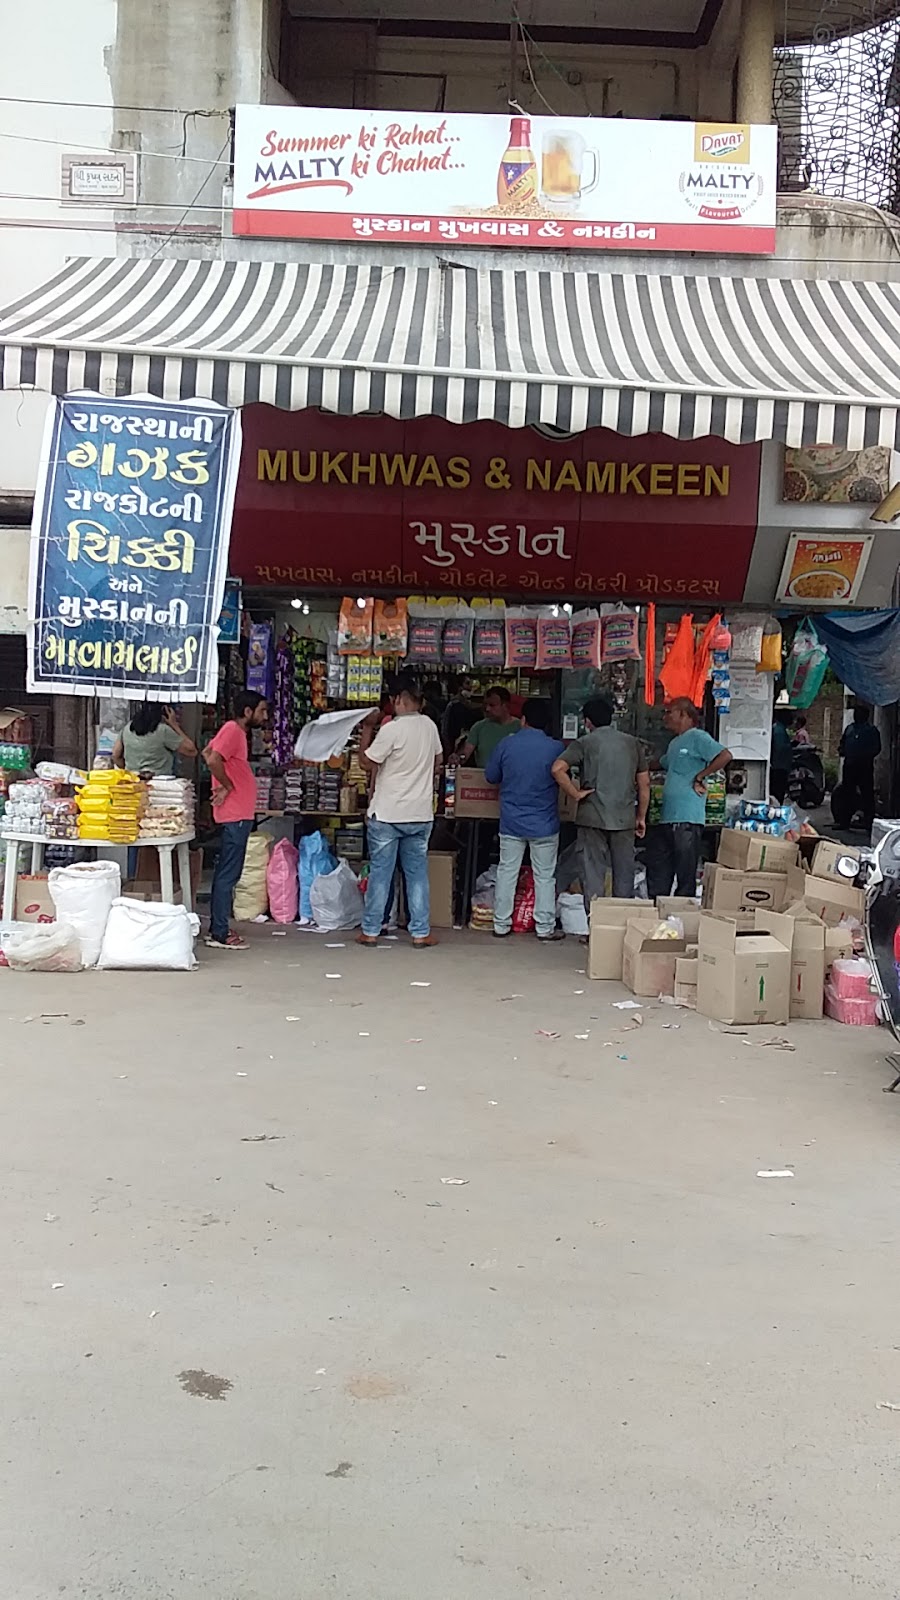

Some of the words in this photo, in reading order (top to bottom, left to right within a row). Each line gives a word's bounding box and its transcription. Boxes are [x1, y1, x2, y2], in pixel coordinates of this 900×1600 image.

[260, 130, 351, 156] Summer
[358, 126, 378, 151] ki
[384, 120, 460, 150] Rahat...
[254, 156, 344, 182] MALTY
[351, 152, 371, 178] ki
[376, 146, 465, 175] Chahat...
[687, 172, 754, 189] MALTY
[352, 217, 431, 235] મુસ્કાન
[438, 220, 529, 239] મુખવાસ
[537, 221, 565, 238] &
[573, 222, 656, 240] નમકીન
[700, 206, 739, 217] Flavoured
[70, 413, 214, 443] રાજસ્થાની
[66, 441, 210, 485] ગઝક
[258, 449, 471, 489] MUKHWAS
[484, 457, 512, 490] &
[526, 459, 730, 496] NAMKEEN
[64, 486, 203, 523] રાજકોટની
[66, 519, 195, 573] ચિક્કી
[409, 521, 571, 567] મુસ્કાન
[108, 575, 143, 594] અને
[57, 595, 189, 627] મુસ્કાનની
[45, 635, 198, 675] માવામલાઈ
